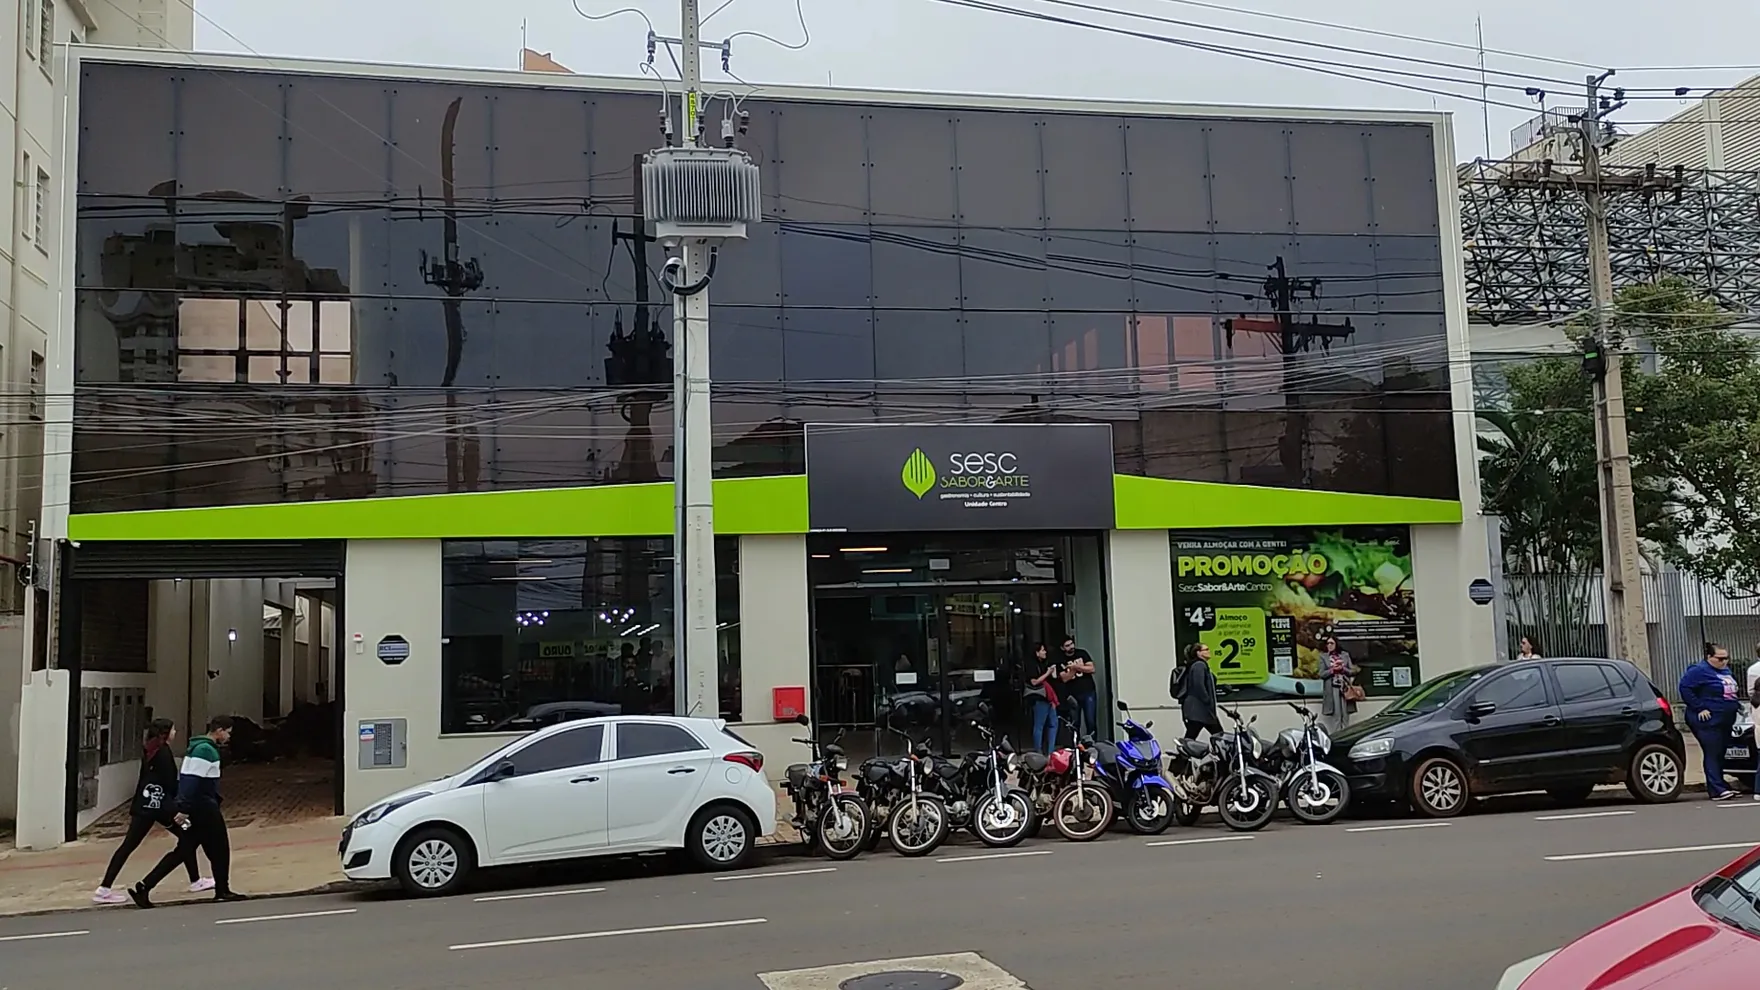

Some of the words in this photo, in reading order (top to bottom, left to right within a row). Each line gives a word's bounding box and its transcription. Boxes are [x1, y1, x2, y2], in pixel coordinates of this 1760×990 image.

[950, 452, 1018, 474] sesc
[940, 475, 1029, 489] SABOR&ARTE
[1177, 541, 1201, 549] VENHA
[1203, 541, 1237, 549] ALMOÇAR
[1262, 540, 1287, 548] GENTE!
[1178, 549, 1328, 579] PROMOÇÃO
